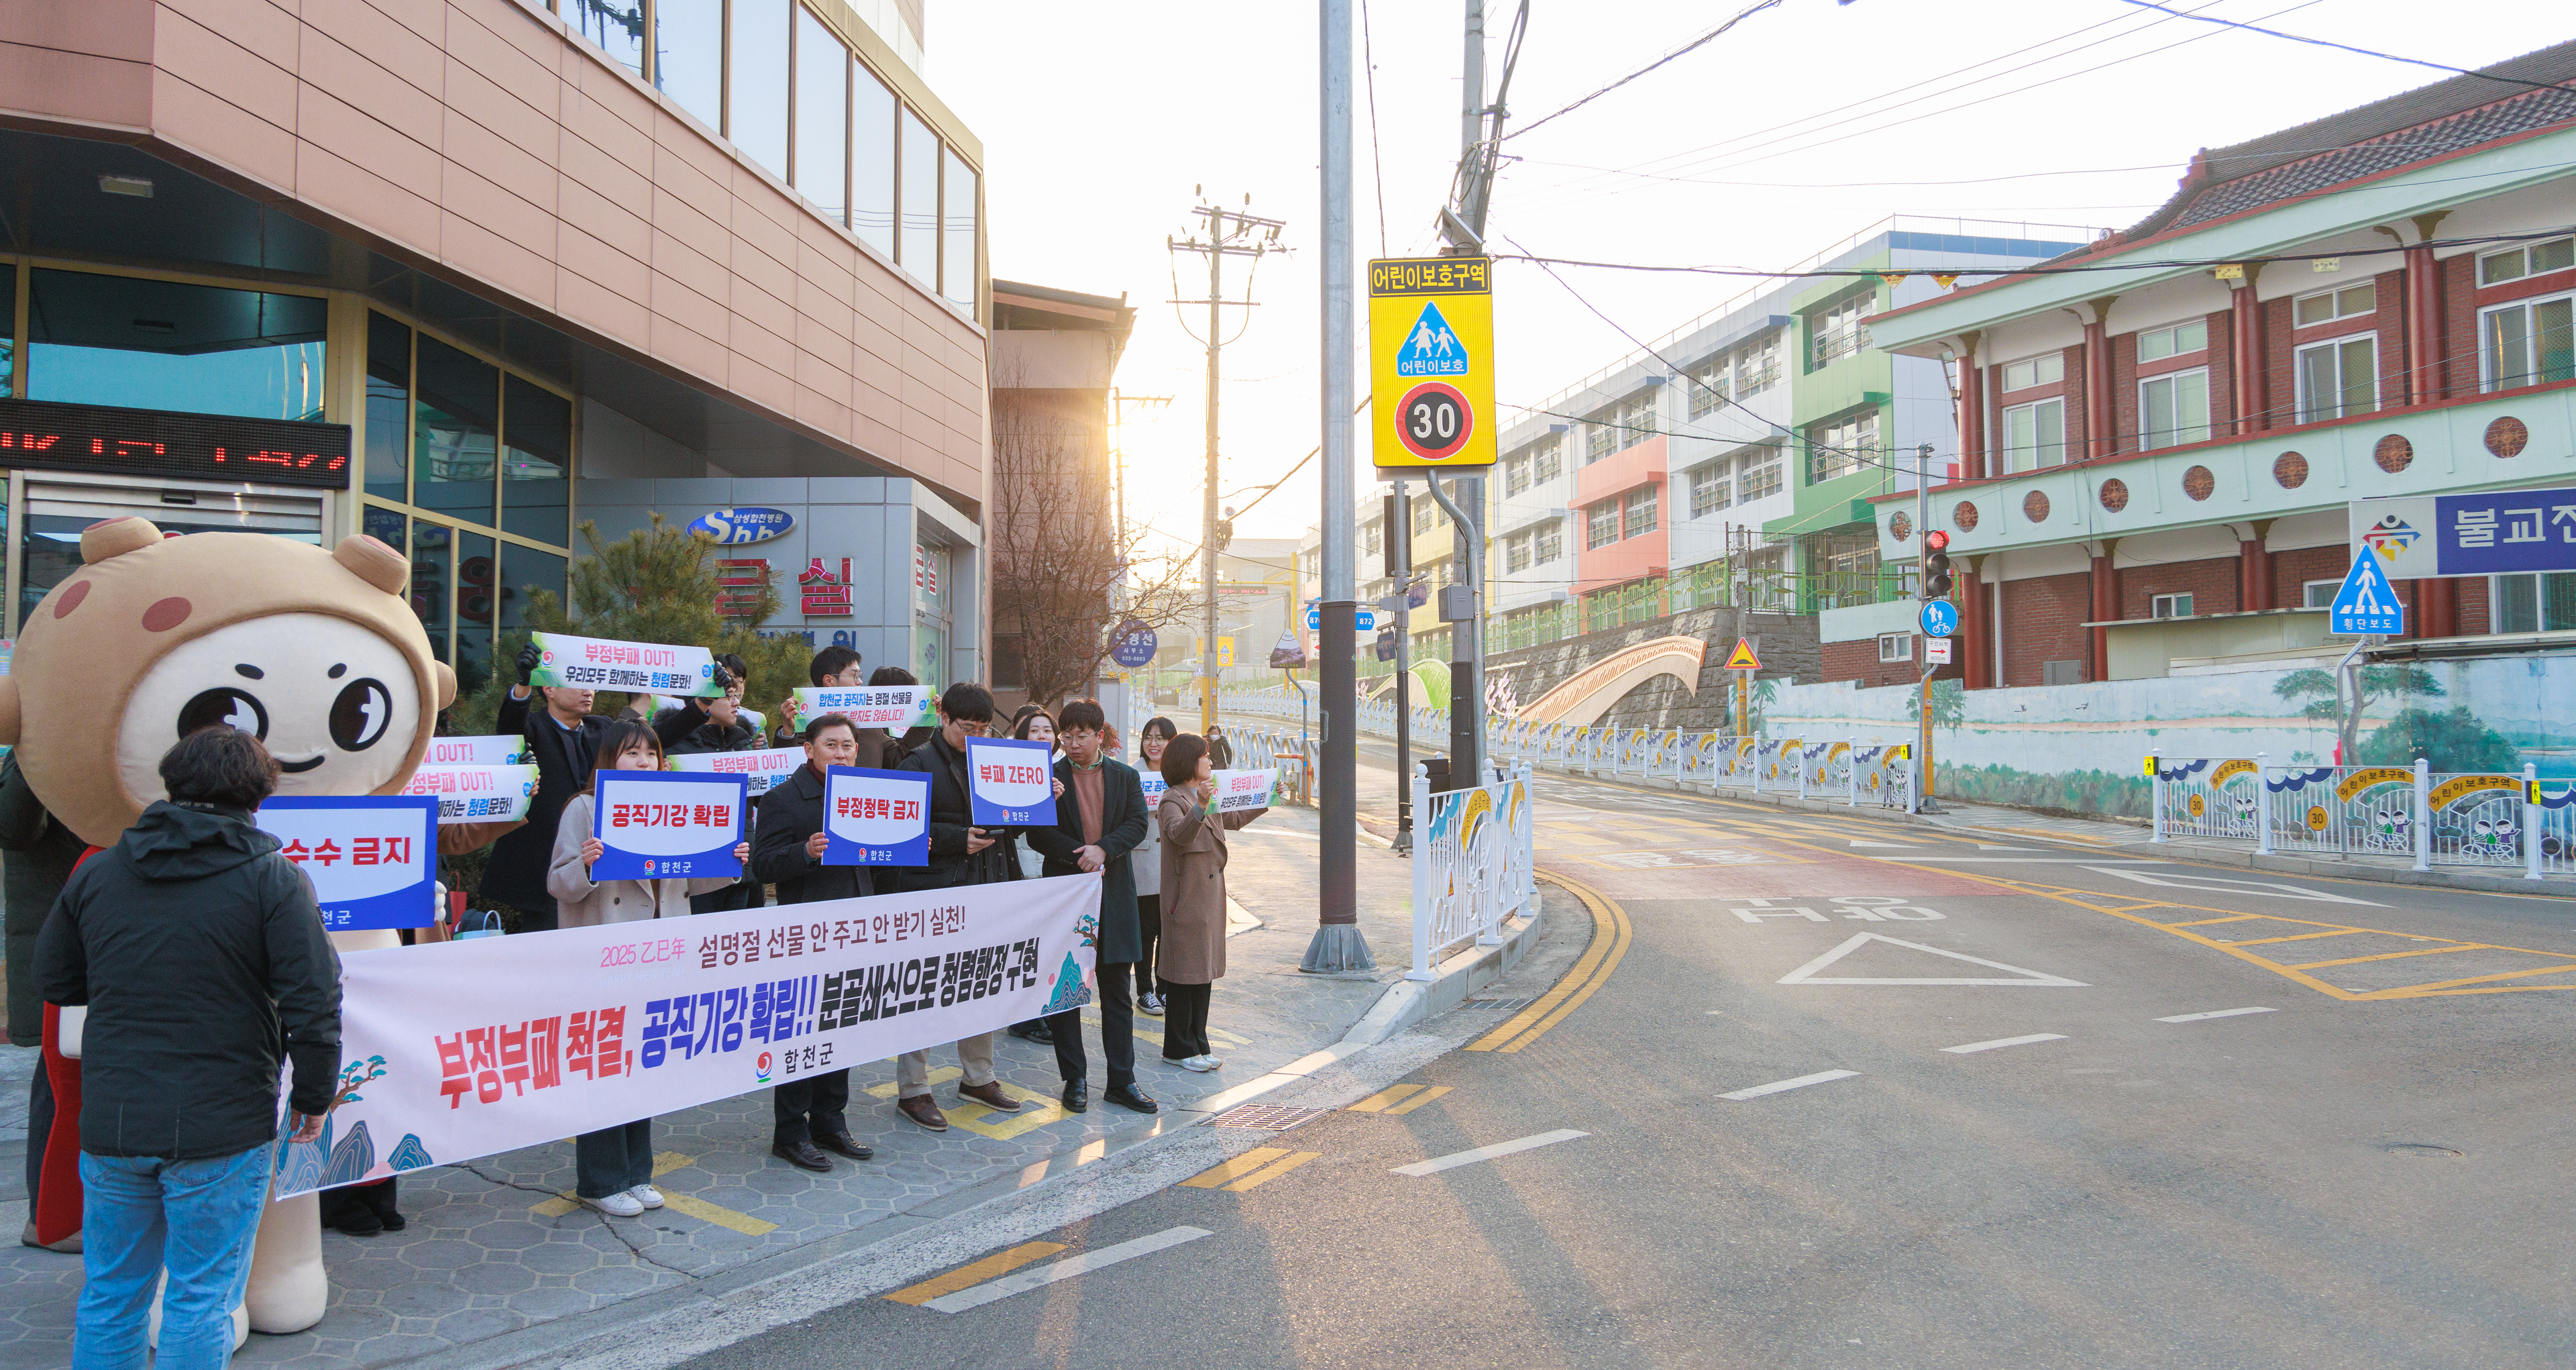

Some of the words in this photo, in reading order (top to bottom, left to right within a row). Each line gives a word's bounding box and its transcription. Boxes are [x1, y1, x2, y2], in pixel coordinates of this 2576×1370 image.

[1374, 264, 1485, 290] 어린이보호구역
[1401, 359, 1464, 374] 어린이보호
[1413, 403, 1455, 438] 30
[733, 513, 784, 523] 삼성합천병원
[712, 558, 854, 615] 급실
[2343, 617, 2394, 631] 횡단보도
[586, 643, 640, 666] 부정부패
[644, 649, 675, 668] OUT!
[565, 666, 607, 683] 우리모두
[608, 668, 649, 687] 함께하는
[651, 672, 692, 690] 청렴문화!
[818, 693, 843, 707] 합천군
[843, 692, 873, 706] 공직자는
[875, 692, 890, 706] 명절
[891, 691, 913, 705] 선물을
[849, 710, 872, 723] 받지도
[873, 708, 905, 723] 않습니다!
[437, 743, 474, 762] OUT!
[712, 755, 759, 773] 부정부패
[761, 753, 789, 772] OUT!
[460, 771, 494, 792] OUT!
[980, 764, 1007, 784] 부패
[1009, 766, 1044, 786] ZERO
[1230, 776, 1252, 793] 부정부패
[1252, 774, 1265, 788] OUT!
[2212, 762, 2253, 785] 어린이보호구역
[2341, 770, 2406, 796] 어린이보호구역
[2430, 776, 2510, 804] 어린이보호구역
[467, 796, 513, 816] 청렴문화!
[837, 796, 890, 821] 부정청탁
[893, 797, 920, 823] 금지
[1220, 796, 1237, 809] 우리모두
[2192, 800, 2201, 810] 30
[612, 804, 688, 828] 공직기강
[693, 804, 730, 828] 확립
[1012, 810, 1030, 823] 합천군
[2312, 812, 2323, 824] 30
[353, 837, 411, 866] 금지
[869, 849, 892, 862] 합천군
[661, 860, 692, 874] 합천군
[321, 910, 352, 925] 천군
[600, 942, 637, 968] 2025
[641, 936, 686, 963] 乙巳年
[698, 927, 761, 969] 설명절
[766, 923, 806, 958] 선물
[810, 921, 828, 953] 안
[833, 918, 868, 949] 주고
[873, 914, 890, 944] 안
[894, 909, 926, 941] 받기
[930, 905, 965, 937] 실천!
[435, 1015, 562, 1110] 부정부패
[566, 1005, 633, 1082] 척결,
[641, 987, 748, 1069] 공직기강
[749, 974, 818, 1045] 확립!!
[818, 955, 941, 1032] 분골쇄신으로
[940, 942, 1009, 1008] 청렴행정
[1008, 937, 1041, 992] 구현
[784, 1042, 834, 1074] 합천군
